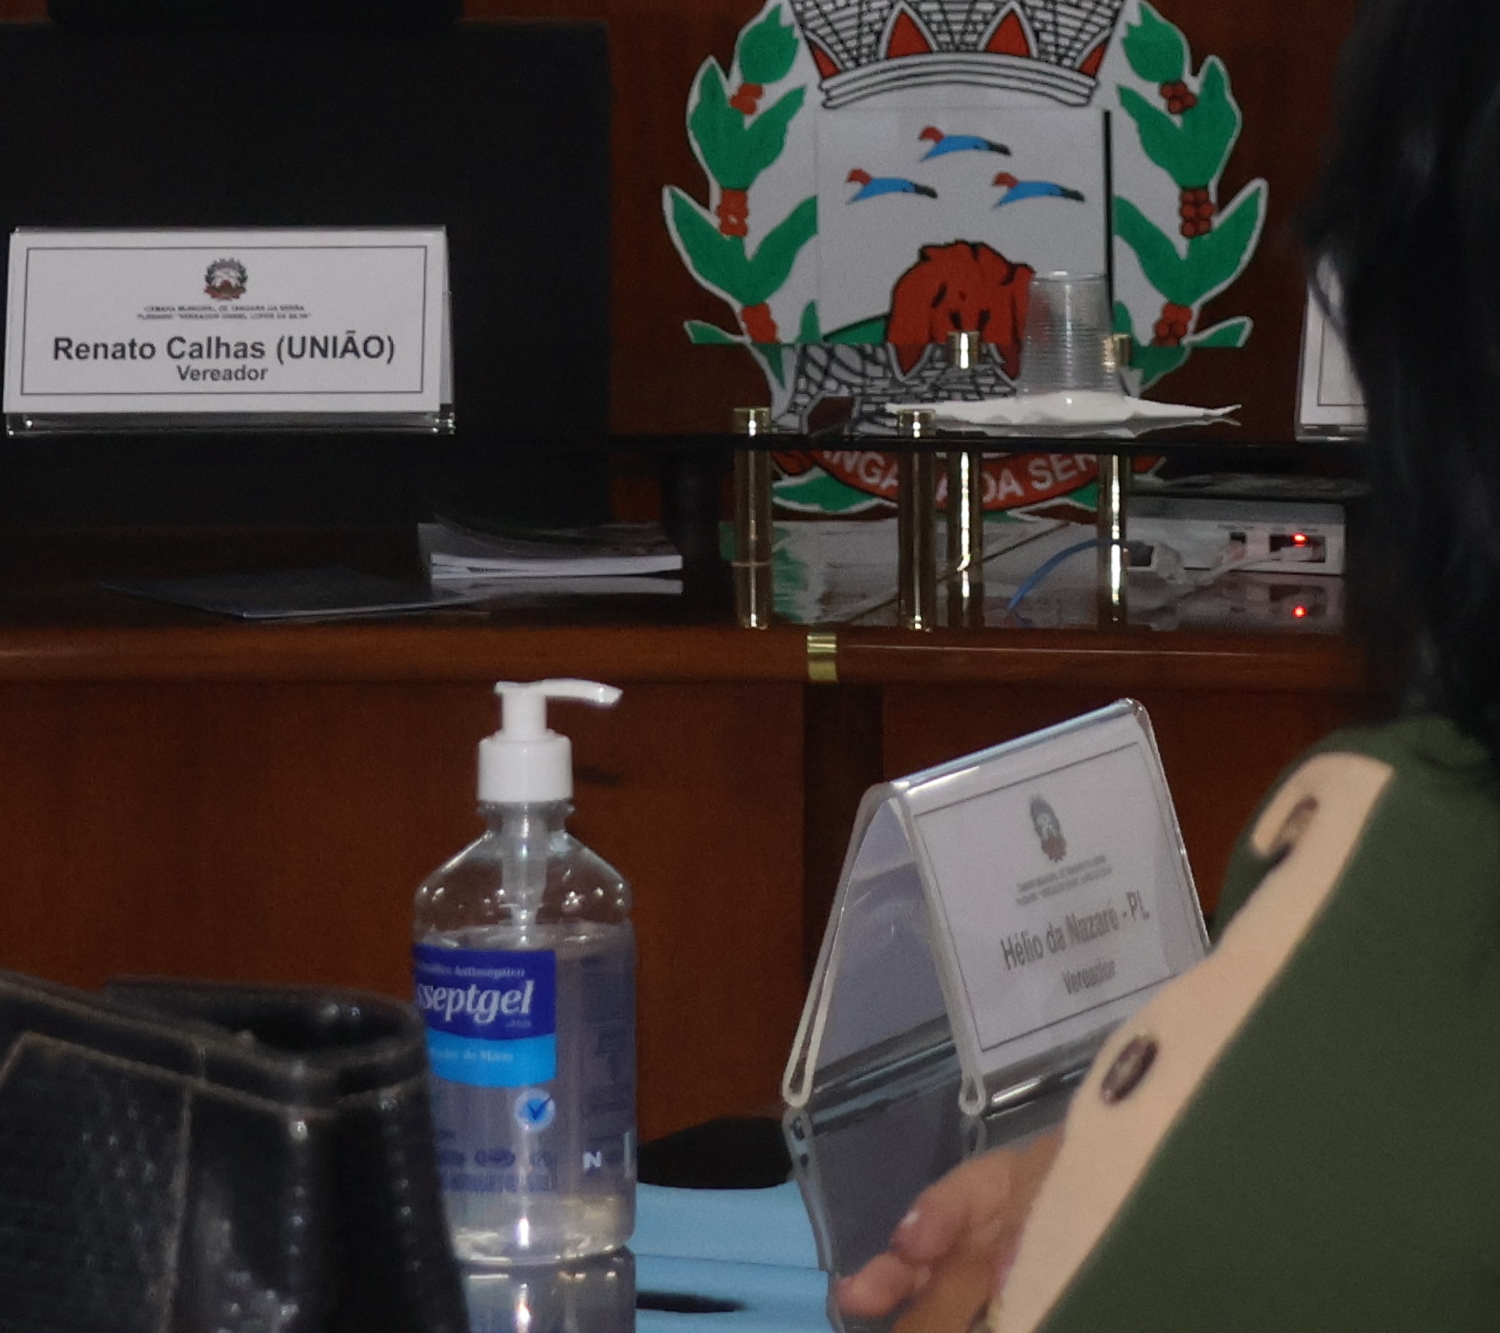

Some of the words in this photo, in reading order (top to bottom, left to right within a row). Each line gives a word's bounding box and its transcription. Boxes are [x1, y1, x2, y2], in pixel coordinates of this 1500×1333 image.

[52, 336, 156, 361] Renato
[166, 335, 266, 360] Calhas
[276, 330, 395, 365] (UNIÃO)
[175, 365, 268, 383] Vereador
